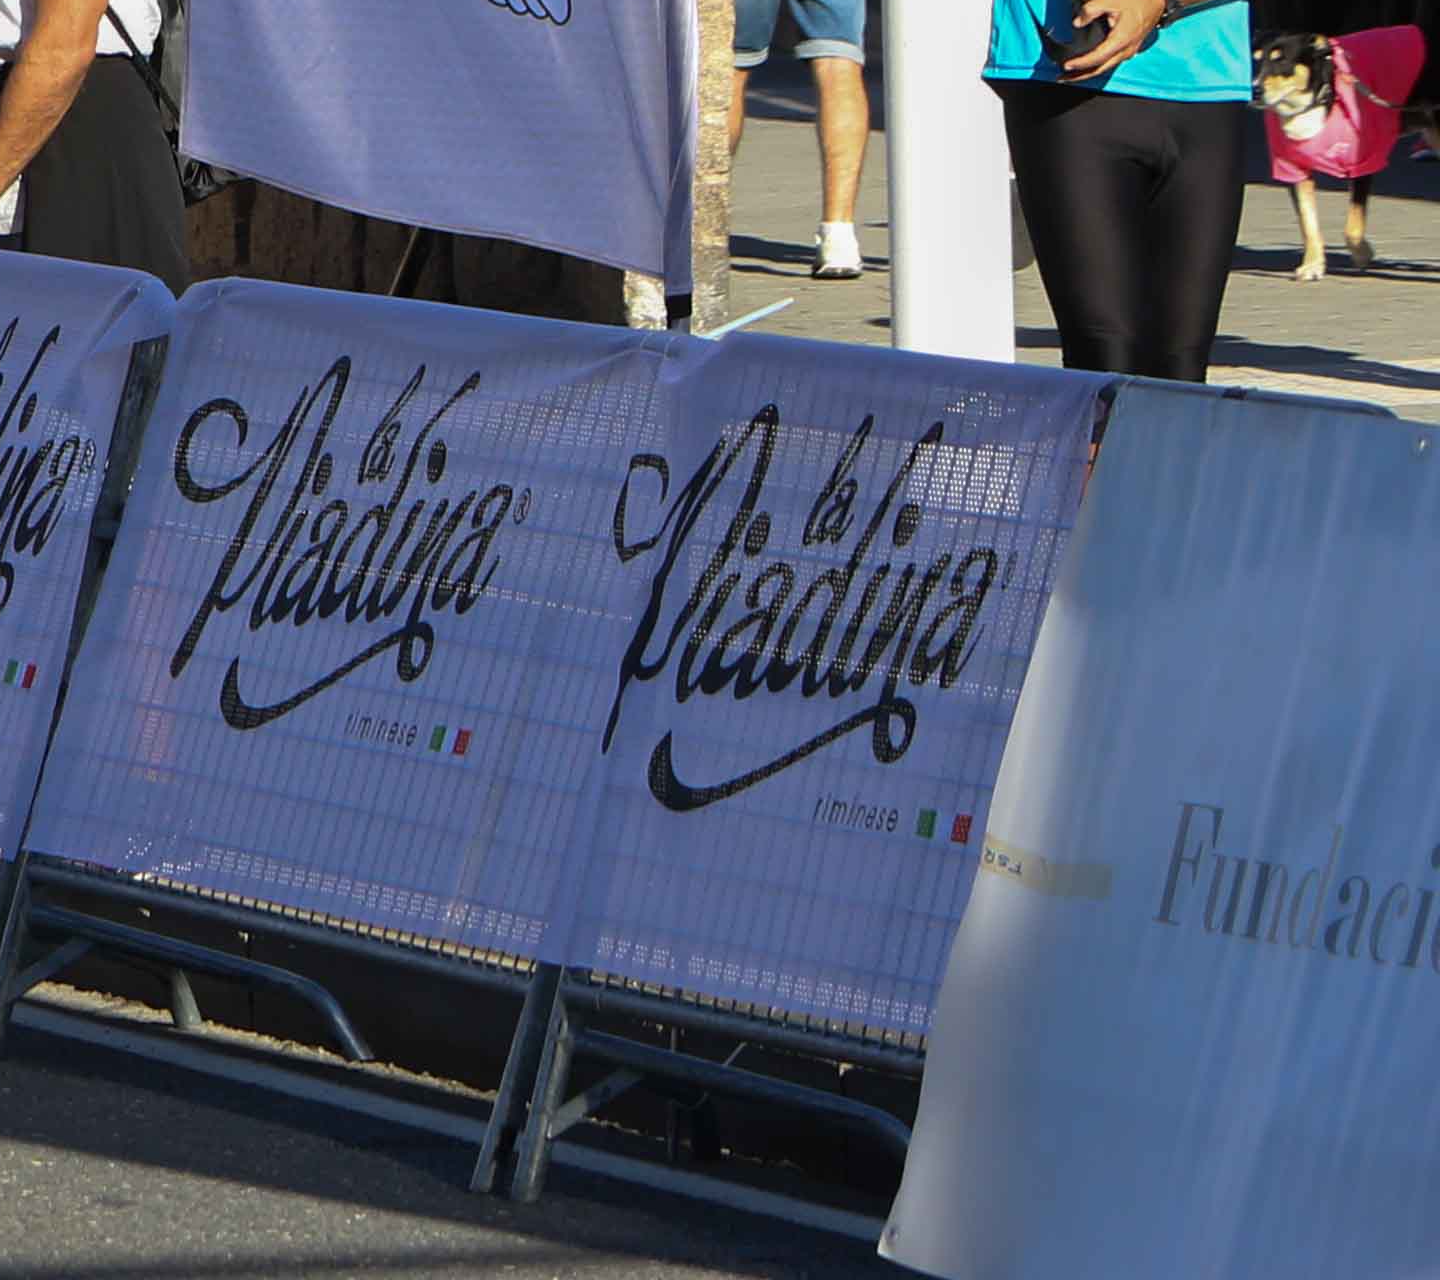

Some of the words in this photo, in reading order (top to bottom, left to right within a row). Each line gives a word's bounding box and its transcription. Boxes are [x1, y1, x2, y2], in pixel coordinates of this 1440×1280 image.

[344, 711, 418, 747] riminese
[813, 792, 899, 834] riminese
[1152, 801, 1440, 977] Fundaci
